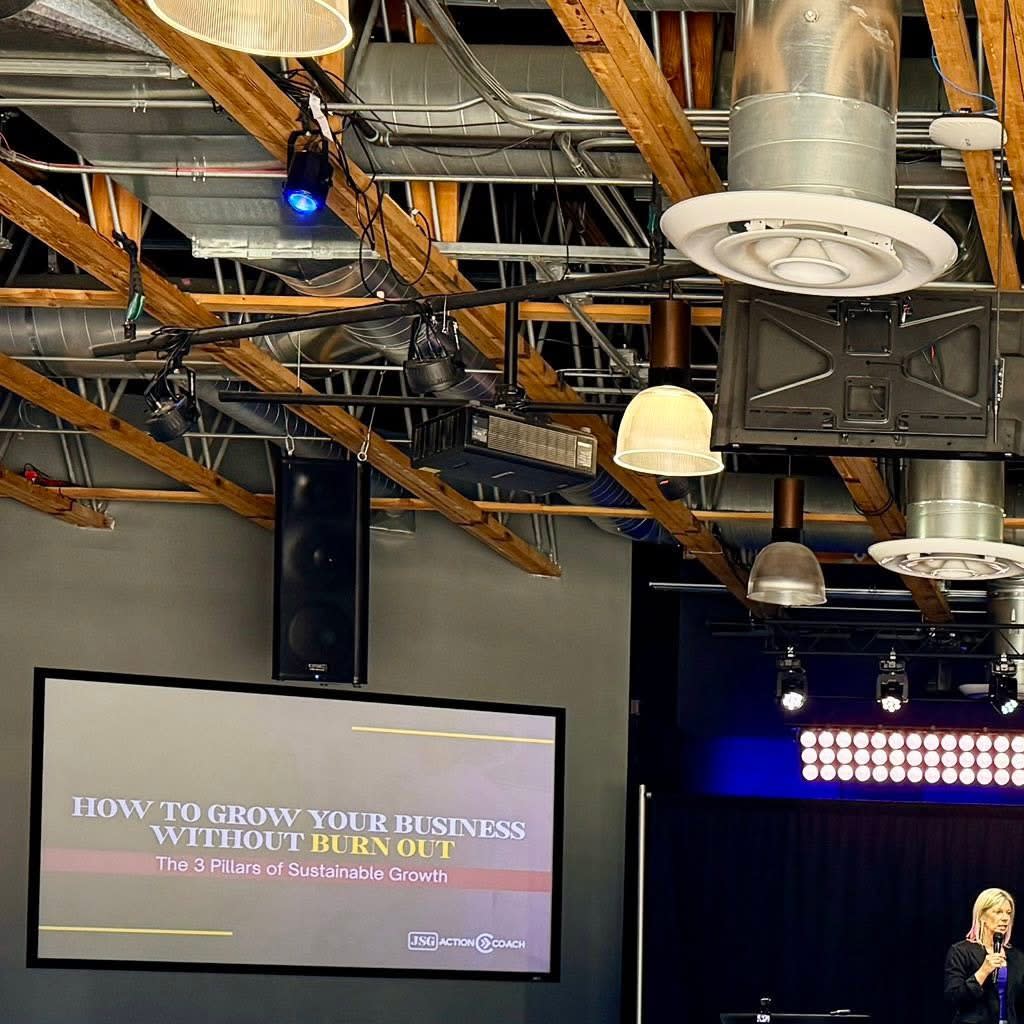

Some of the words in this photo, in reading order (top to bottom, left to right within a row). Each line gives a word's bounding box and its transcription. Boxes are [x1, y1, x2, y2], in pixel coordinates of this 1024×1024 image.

[71, 796, 154, 819] HOW
[160, 801, 201, 822] TO
[207, 804, 301, 827] GROW
[307, 809, 388, 833] YOUR
[393, 814, 526, 840] BUSINESS
[149, 825, 305, 852] WITHOUT
[310, 833, 391, 857] BURN
[396, 838, 456, 859] OUT
[155, 856, 189, 872] The
[194, 858, 205, 872] 3
[210, 859, 261, 875] Pillars
[266, 862, 284, 876] of
[287, 862, 385, 881] Sustainable
[388, 867, 448, 883] Growth
[409, 935, 436, 947] JSG
[439, 938, 475, 947] ACTION
